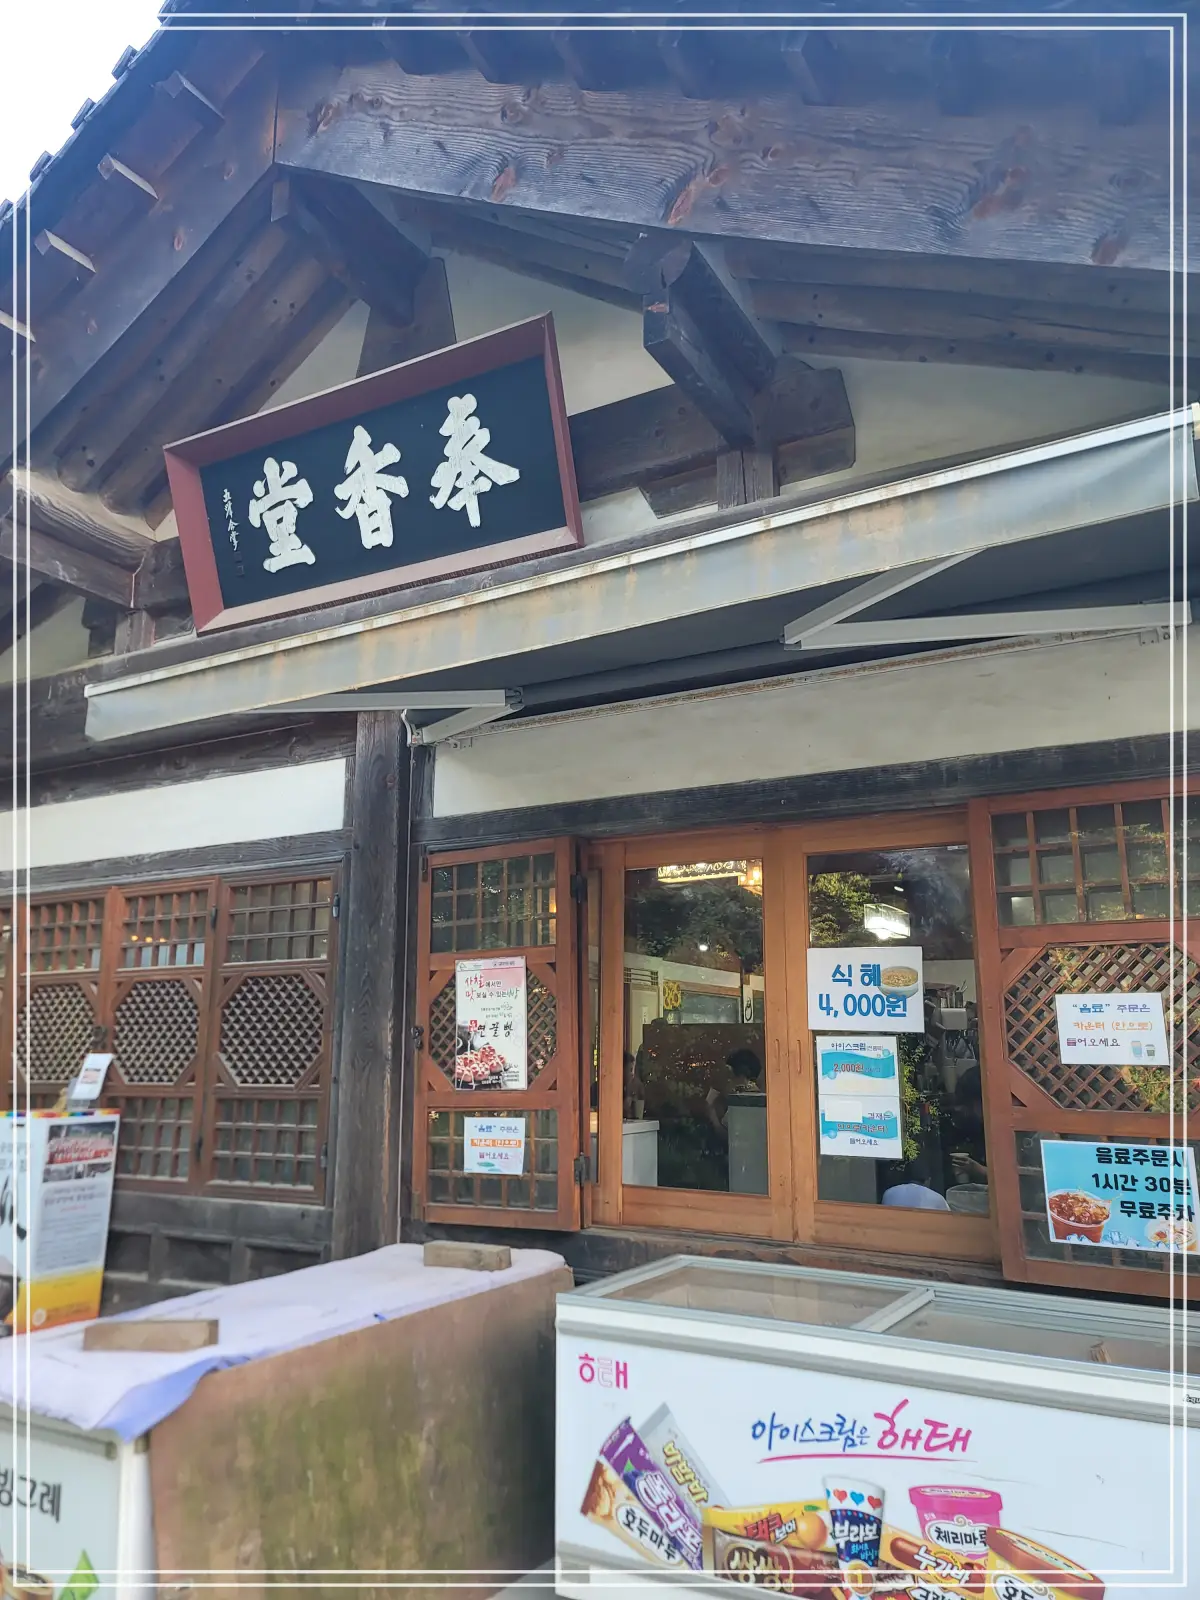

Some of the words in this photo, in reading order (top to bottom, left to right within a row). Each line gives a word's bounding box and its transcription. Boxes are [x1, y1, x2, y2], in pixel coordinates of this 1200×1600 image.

[818, 992, 907, 1018] 4,000원
[1116, 1003, 1151, 1014] 주문은
[1072, 1021, 1105, 1031] 카운터
[1066, 1037, 1121, 1047] 들어오세요
[833, 1063, 864, 1073] 2,000원
[1096, 1147, 1186, 1168] 음료주문시
[1092, 1173, 1139, 1192] 1시간
[1144, 1176, 1192, 1196] 30분
[1120, 1200, 1195, 1222] 무료주차
[751, 1411, 871, 1452] 아이스크림은
[833, 1520, 880, 1549] 부라보
